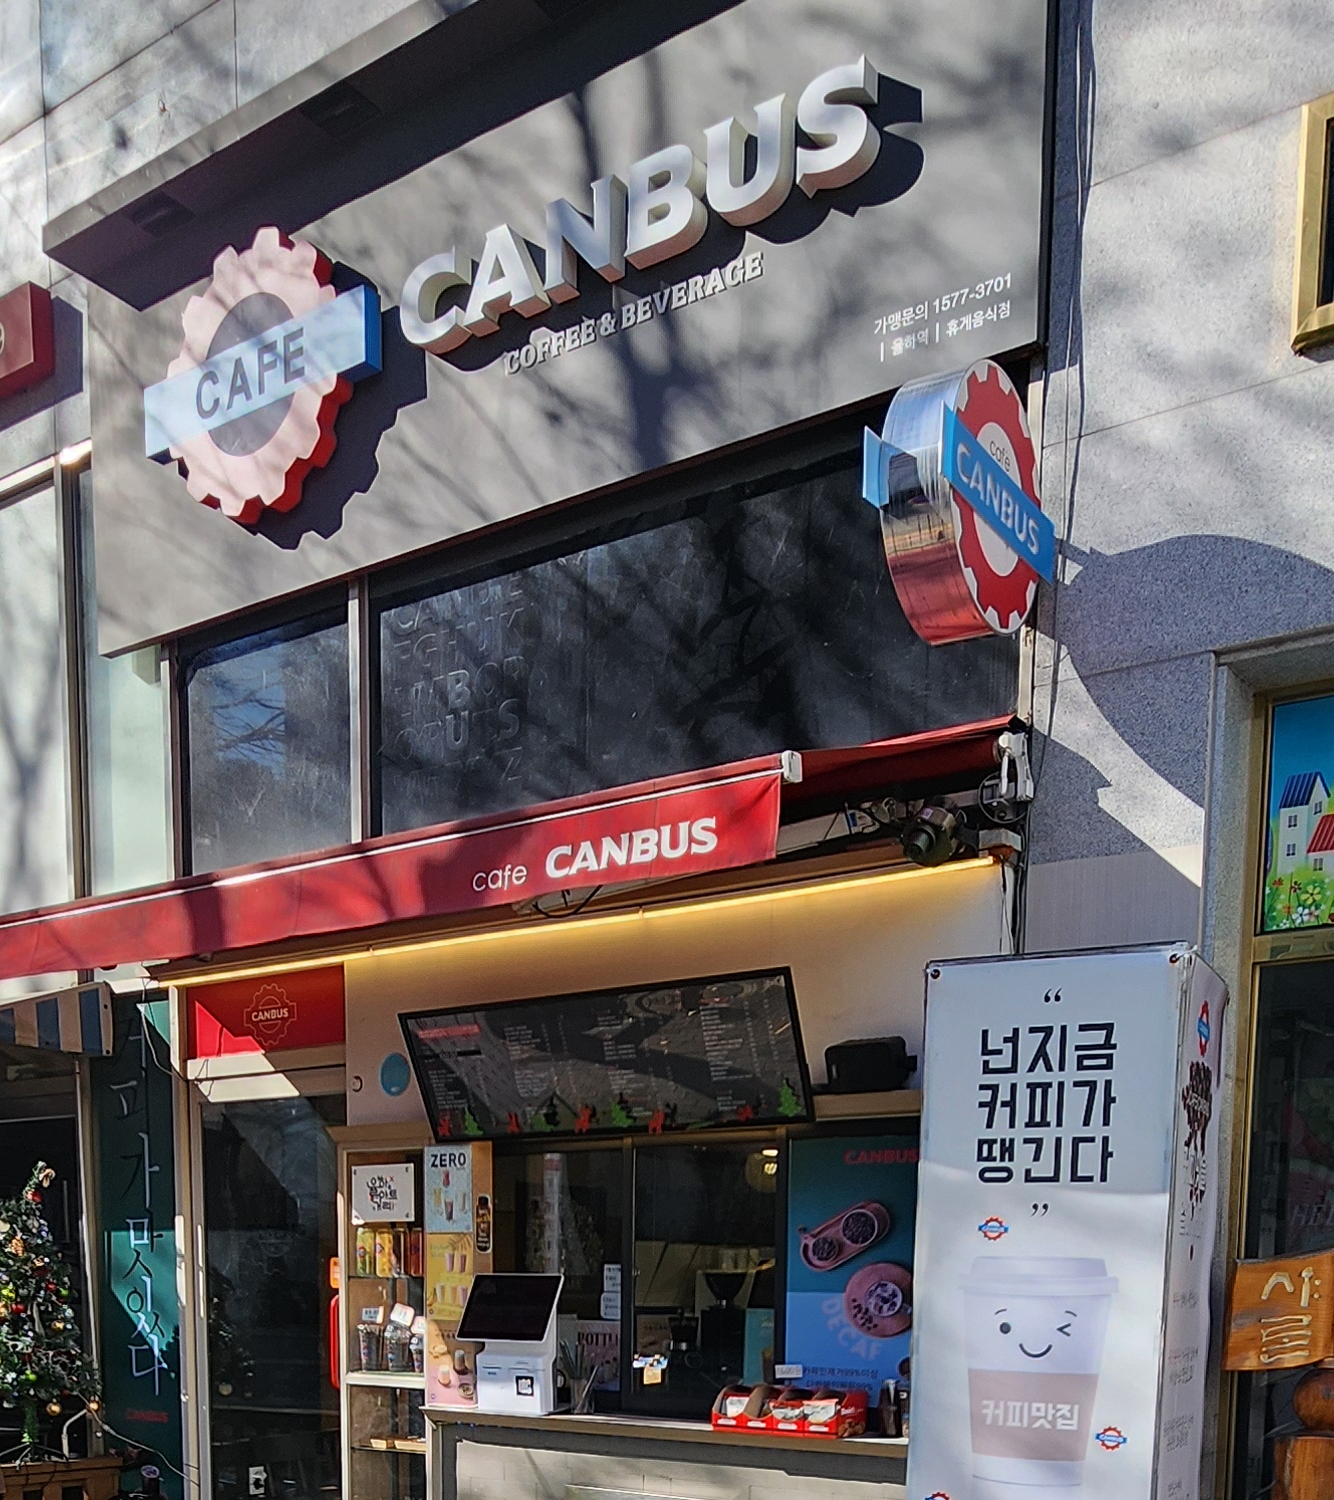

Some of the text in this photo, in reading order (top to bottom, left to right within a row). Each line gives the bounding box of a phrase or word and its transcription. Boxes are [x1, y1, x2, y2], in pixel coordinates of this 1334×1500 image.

[399, 55, 880, 354] CANBUS
[505, 315, 595, 377] COFFEE
[620, 250, 765, 333] BEVERAGE
[874, 272, 1012, 335] 가맹문의 1577-3701
[945, 300, 1012, 338] 휴게음식점
[193, 326, 308, 421] CAFE
[956, 442, 1040, 556] CANBUS
[472, 816, 719, 893] cafe CANBUS
[251, 1006, 291, 1022] CANBUS
[978, 1079, 1117, 1130] 커피가
[430, 1152, 467, 1169] ZERO
[976, 1135, 1114, 1184] 땡긴다
[980, 1399, 1080, 1432] 커피맛집
